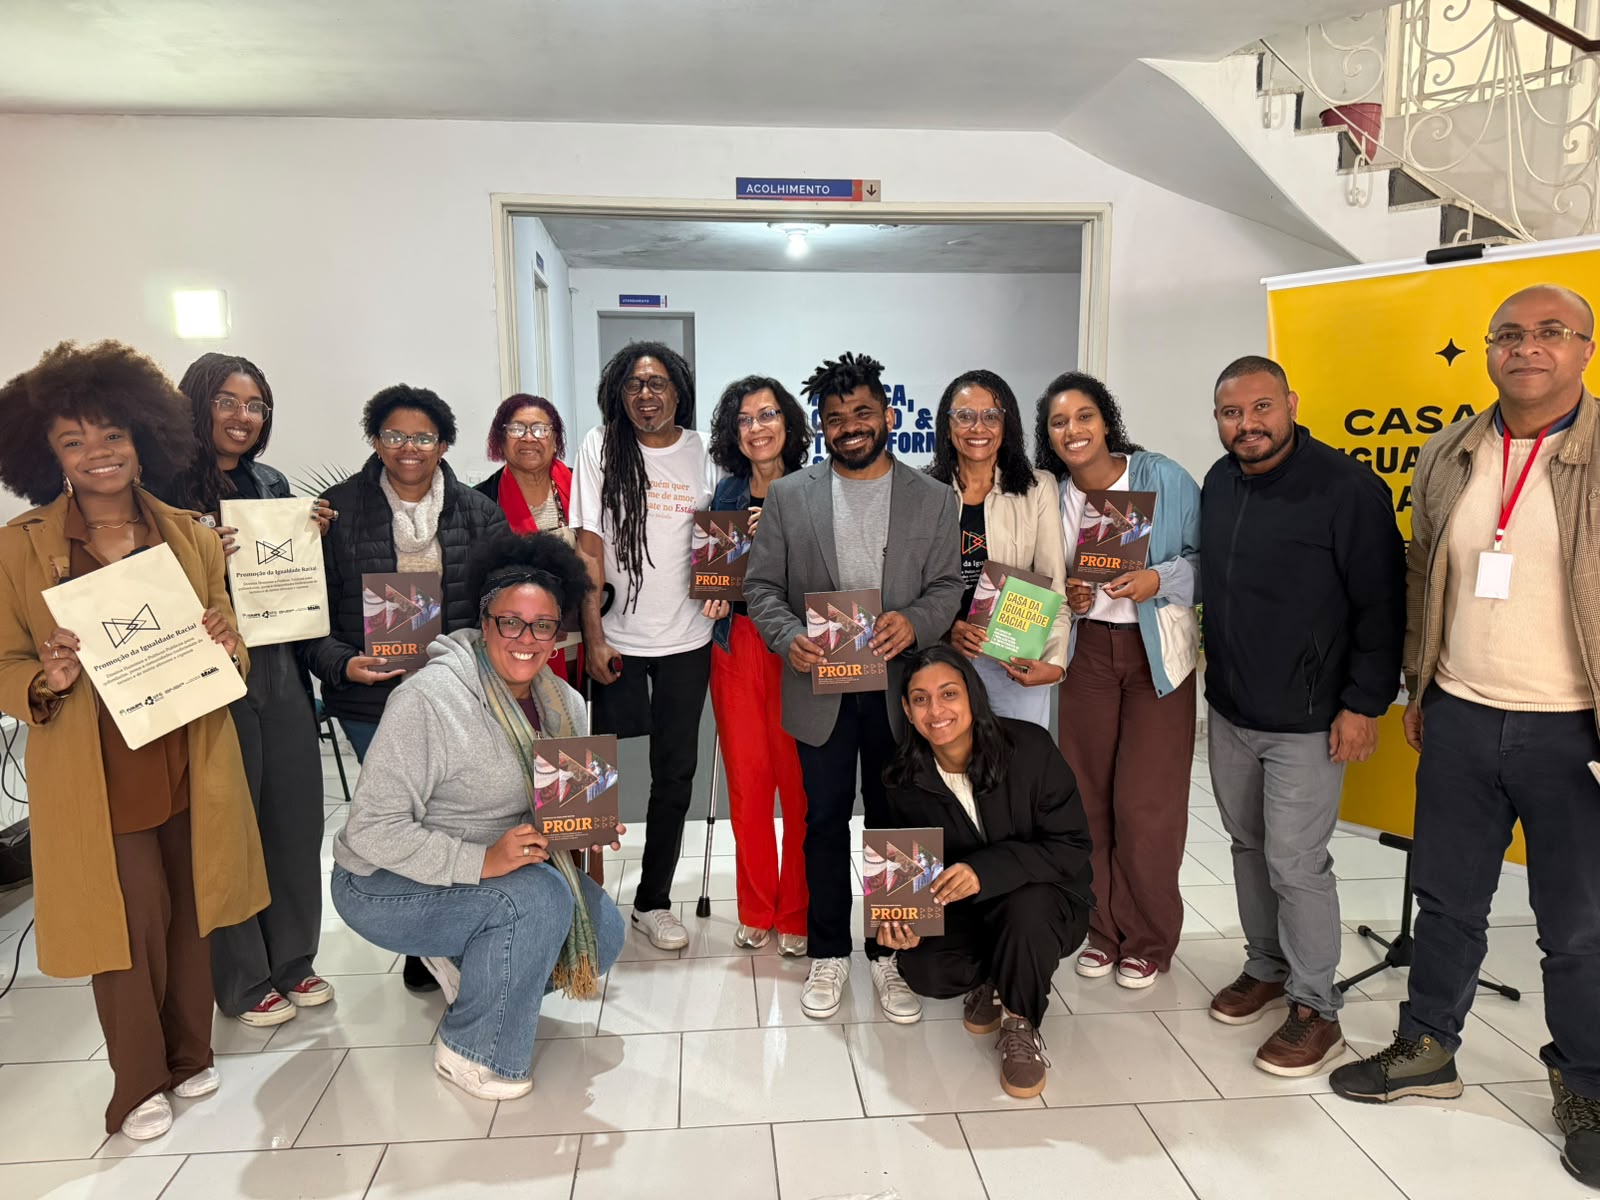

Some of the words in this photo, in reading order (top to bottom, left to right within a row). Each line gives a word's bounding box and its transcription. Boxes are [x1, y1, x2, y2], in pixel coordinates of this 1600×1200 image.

[746, 184, 830, 195] ACOLHIMENTO
[671, 482, 690, 491] quer
[661, 491, 672, 499] de
[662, 504, 674, 512] no
[1079, 555, 1121, 569] PROIR
[275, 567, 301, 576] Igualdade
[695, 575, 730, 586] PROIR
[1006, 592, 1029, 608] CASA
[1028, 598, 1040, 612] DA
[1002, 602, 1048, 626] IGUALDADE
[998, 613, 1028, 631] RACIAL
[94, 652, 130, 672] Promoção
[130, 648, 140, 656] da
[140, 633, 176, 652] Igualdade
[175, 622, 198, 638] Racial
[372, 643, 418, 656] PROIR
[817, 663, 863, 678] PROIR
[542, 817, 593, 834] PROIR
[870, 907, 919, 920] PROIR
